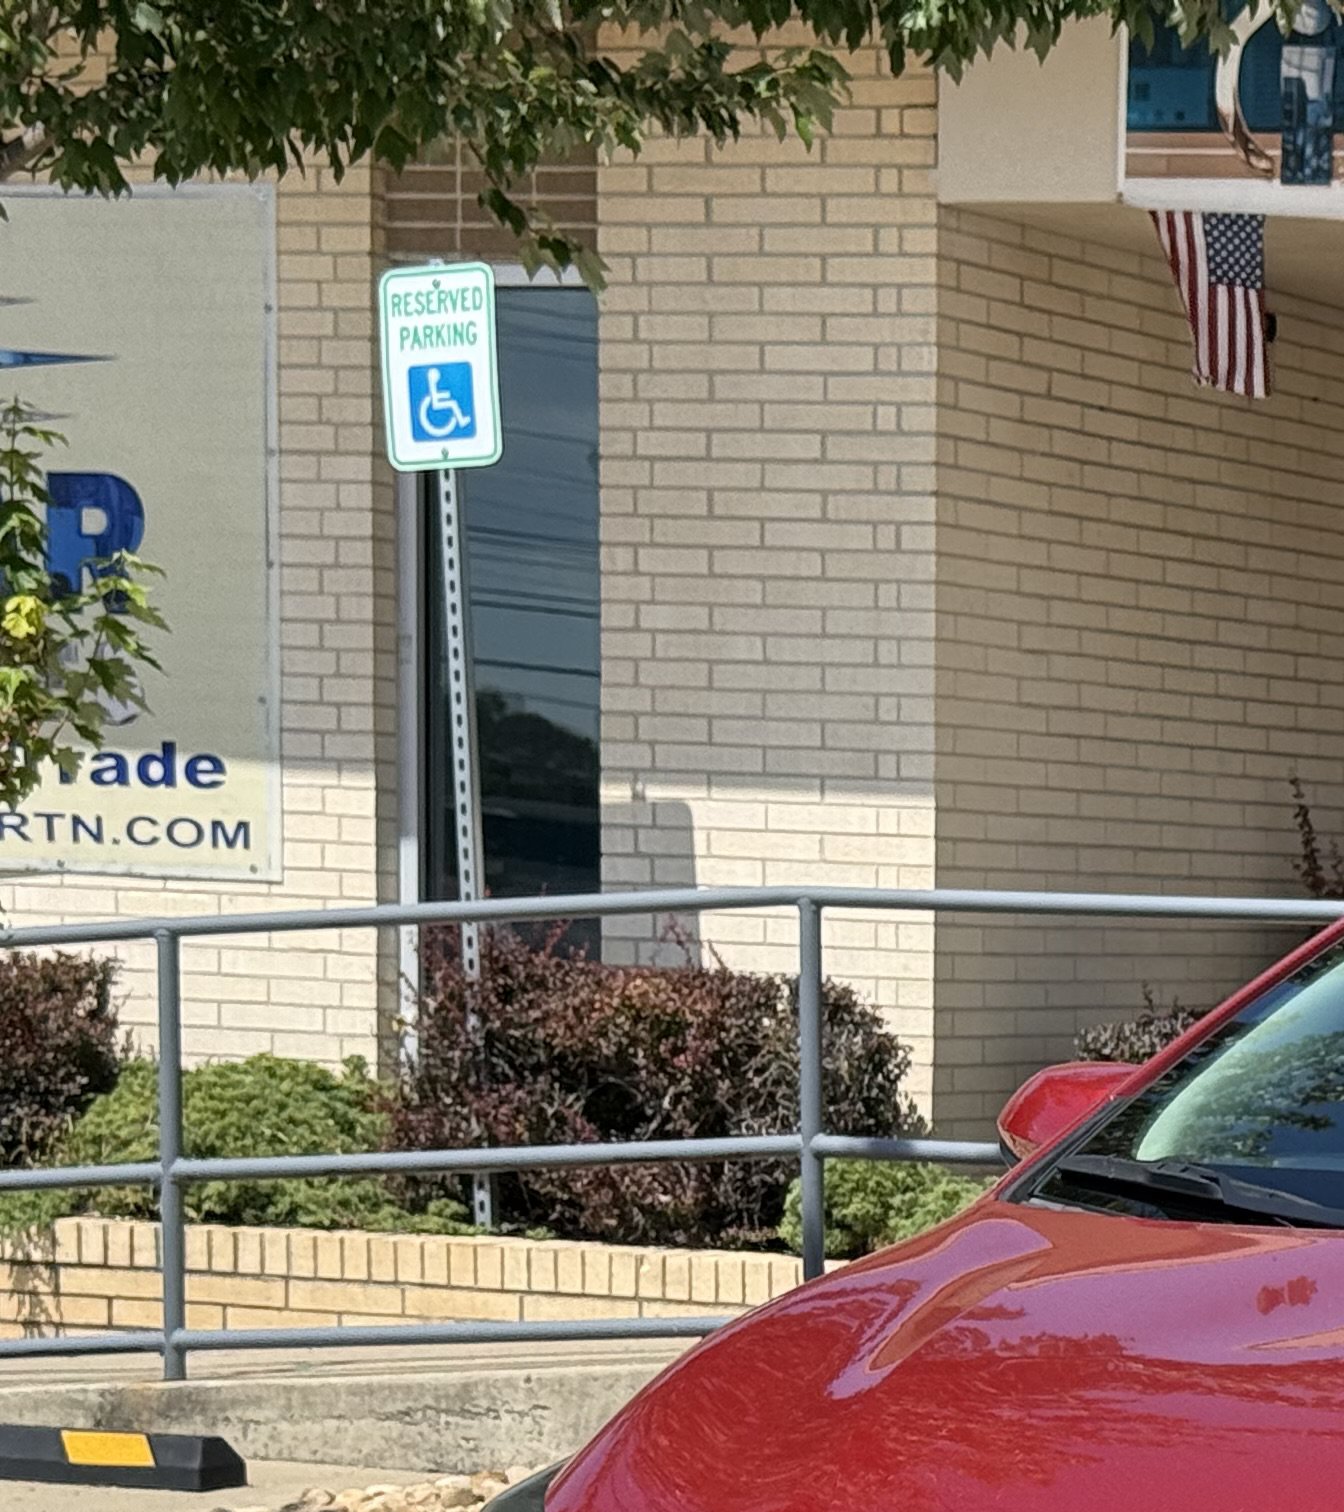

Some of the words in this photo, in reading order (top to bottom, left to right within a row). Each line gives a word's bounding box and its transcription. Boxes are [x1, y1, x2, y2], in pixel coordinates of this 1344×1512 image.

[391, 286, 483, 318] RESERVED
[399, 320, 478, 352] PARKING
[20, 740, 227, 789] ade
